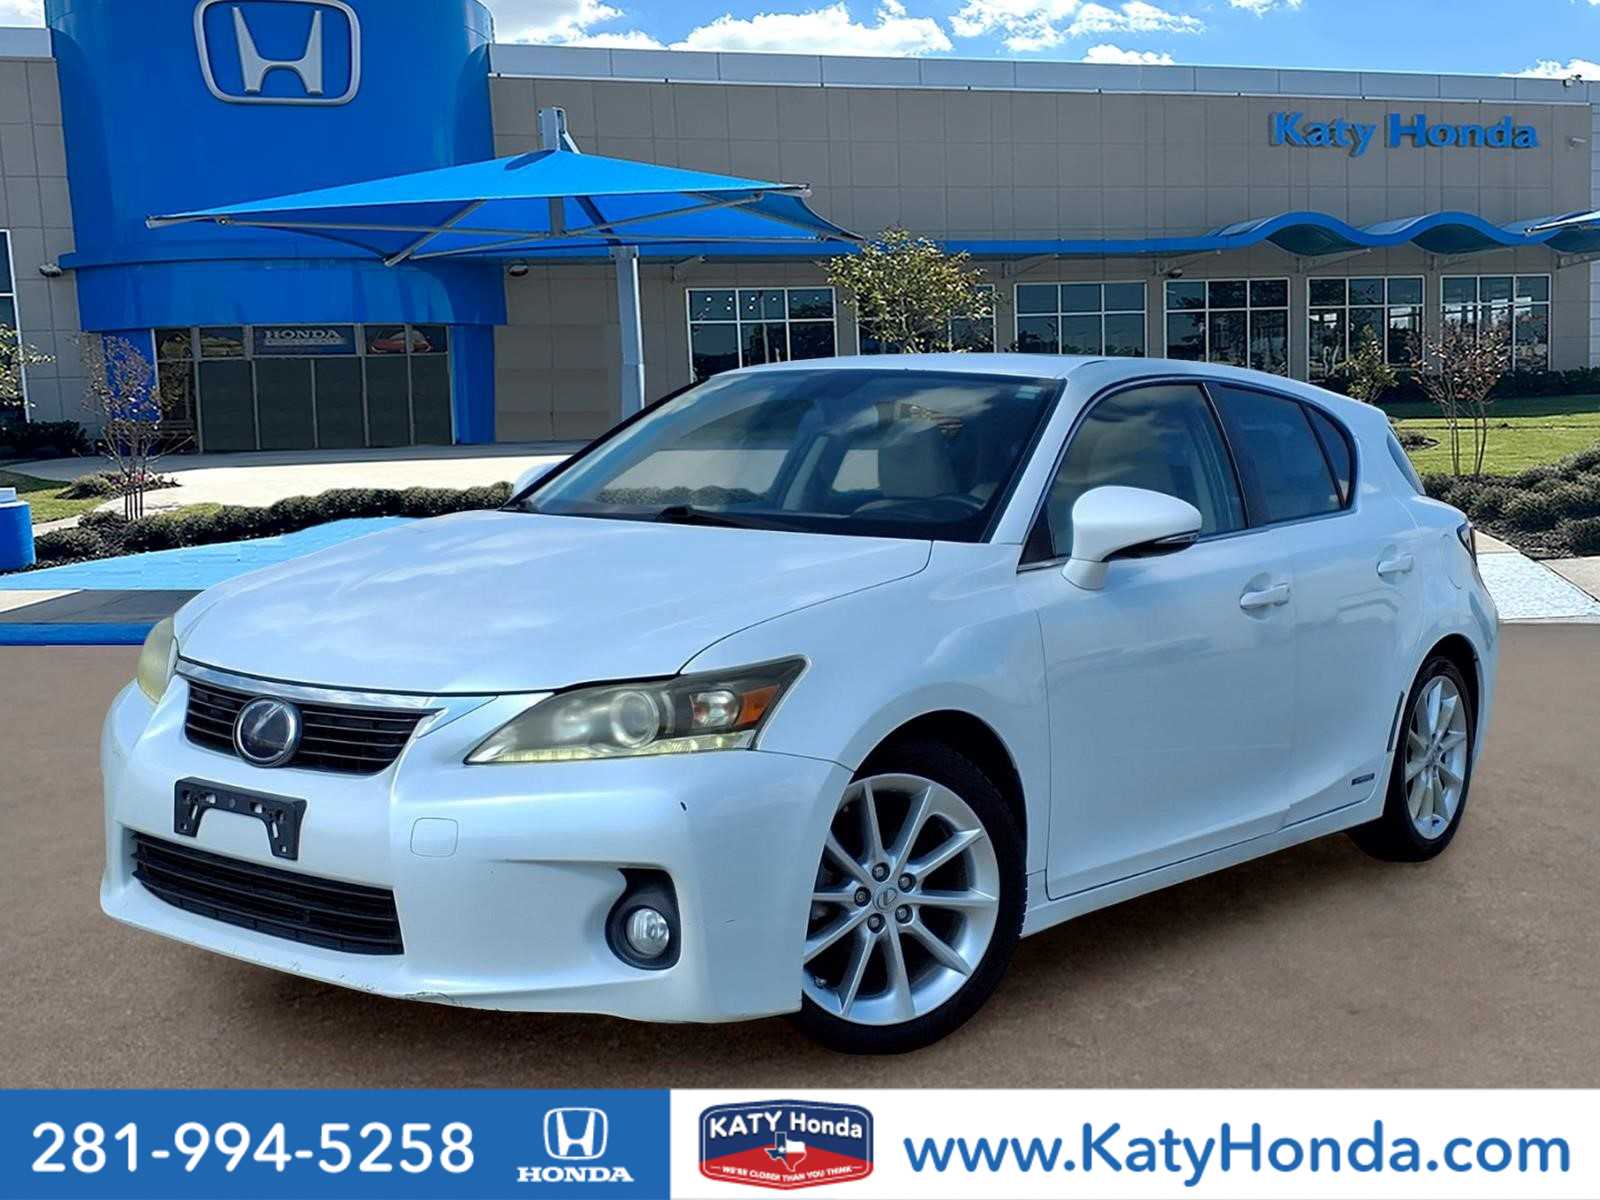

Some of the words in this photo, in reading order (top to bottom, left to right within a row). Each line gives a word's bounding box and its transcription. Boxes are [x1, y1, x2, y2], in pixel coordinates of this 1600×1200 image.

[1271, 112, 1377, 155] Katy
[1387, 112, 1538, 148] Honda
[265, 329, 341, 339] HONDA
